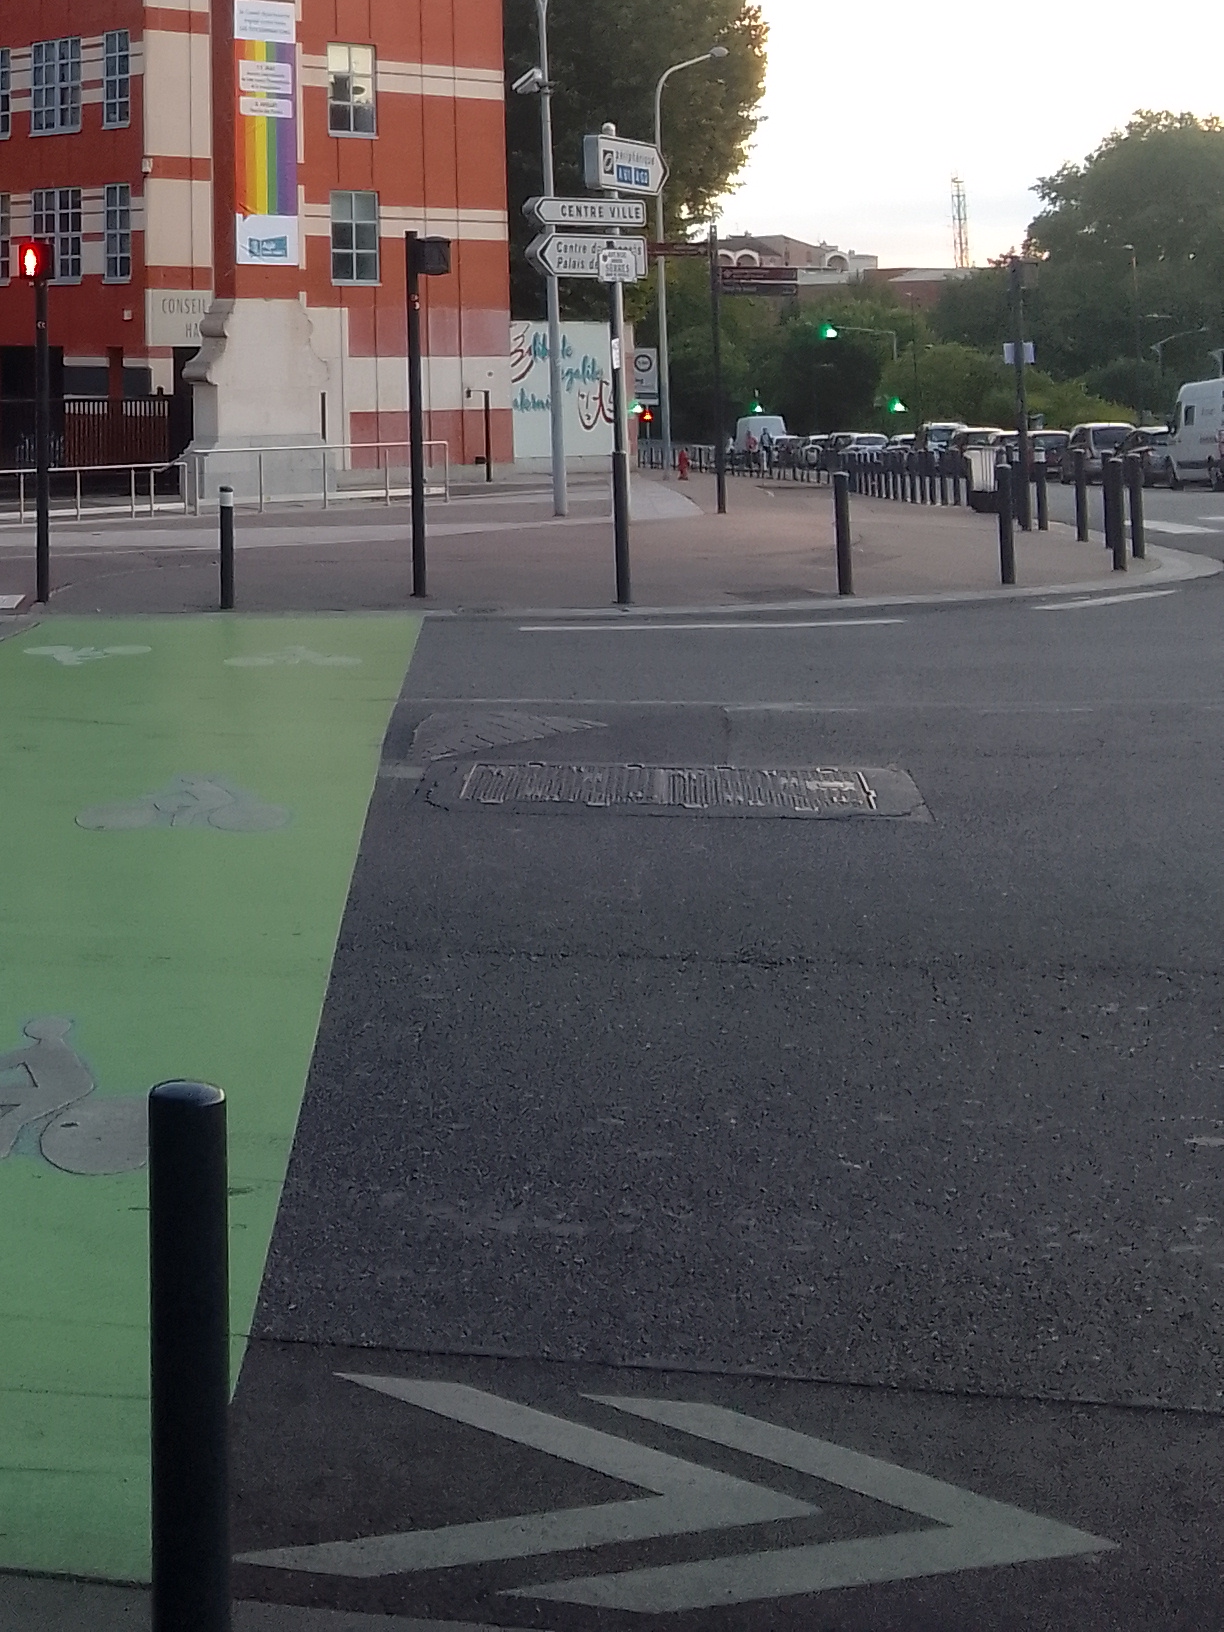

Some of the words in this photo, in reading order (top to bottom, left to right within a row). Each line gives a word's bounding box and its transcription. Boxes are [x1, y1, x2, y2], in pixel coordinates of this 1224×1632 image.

[560, 204, 605, 218] CENTRE
[609, 206, 642, 219] VILLE
[556, 241, 587, 255] Centre
[556, 256, 585, 270] Palais
